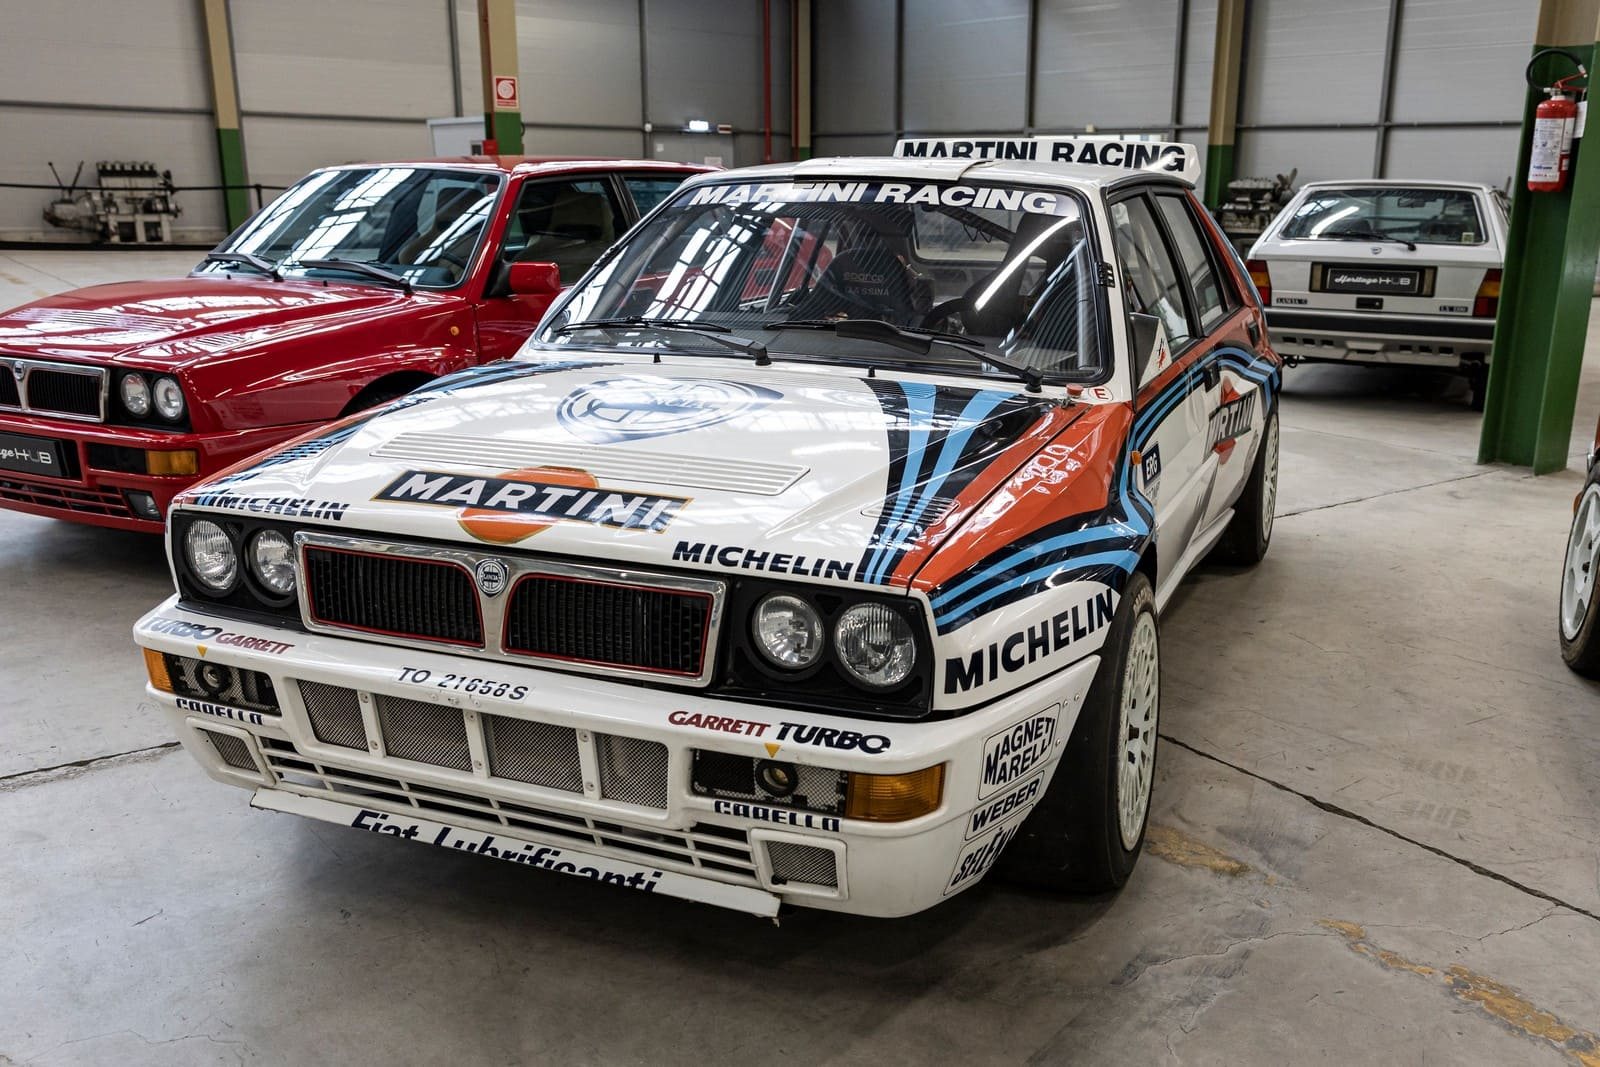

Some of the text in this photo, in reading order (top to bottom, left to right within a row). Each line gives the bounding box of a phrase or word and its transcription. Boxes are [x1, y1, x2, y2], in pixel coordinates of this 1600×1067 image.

[903, 141, 1185, 172] MARTINI RACING
[688, 182, 1057, 215] MARTINI RACING
[1145, 452, 1158, 480] ERG
[216, 496, 350, 521] MICHELIN
[390, 472, 665, 527] MARTINI
[672, 541, 854, 580] MICHELIN
[143, 616, 295, 654] TURBO GARRETT
[944, 588, 1114, 694] MICHELIN
[398, 667, 431, 683] TO
[668, 711, 891, 754] GARRETT TURBO
[983, 717, 1055, 785] MAGNETI
[973, 779, 1040, 832] WEBER
